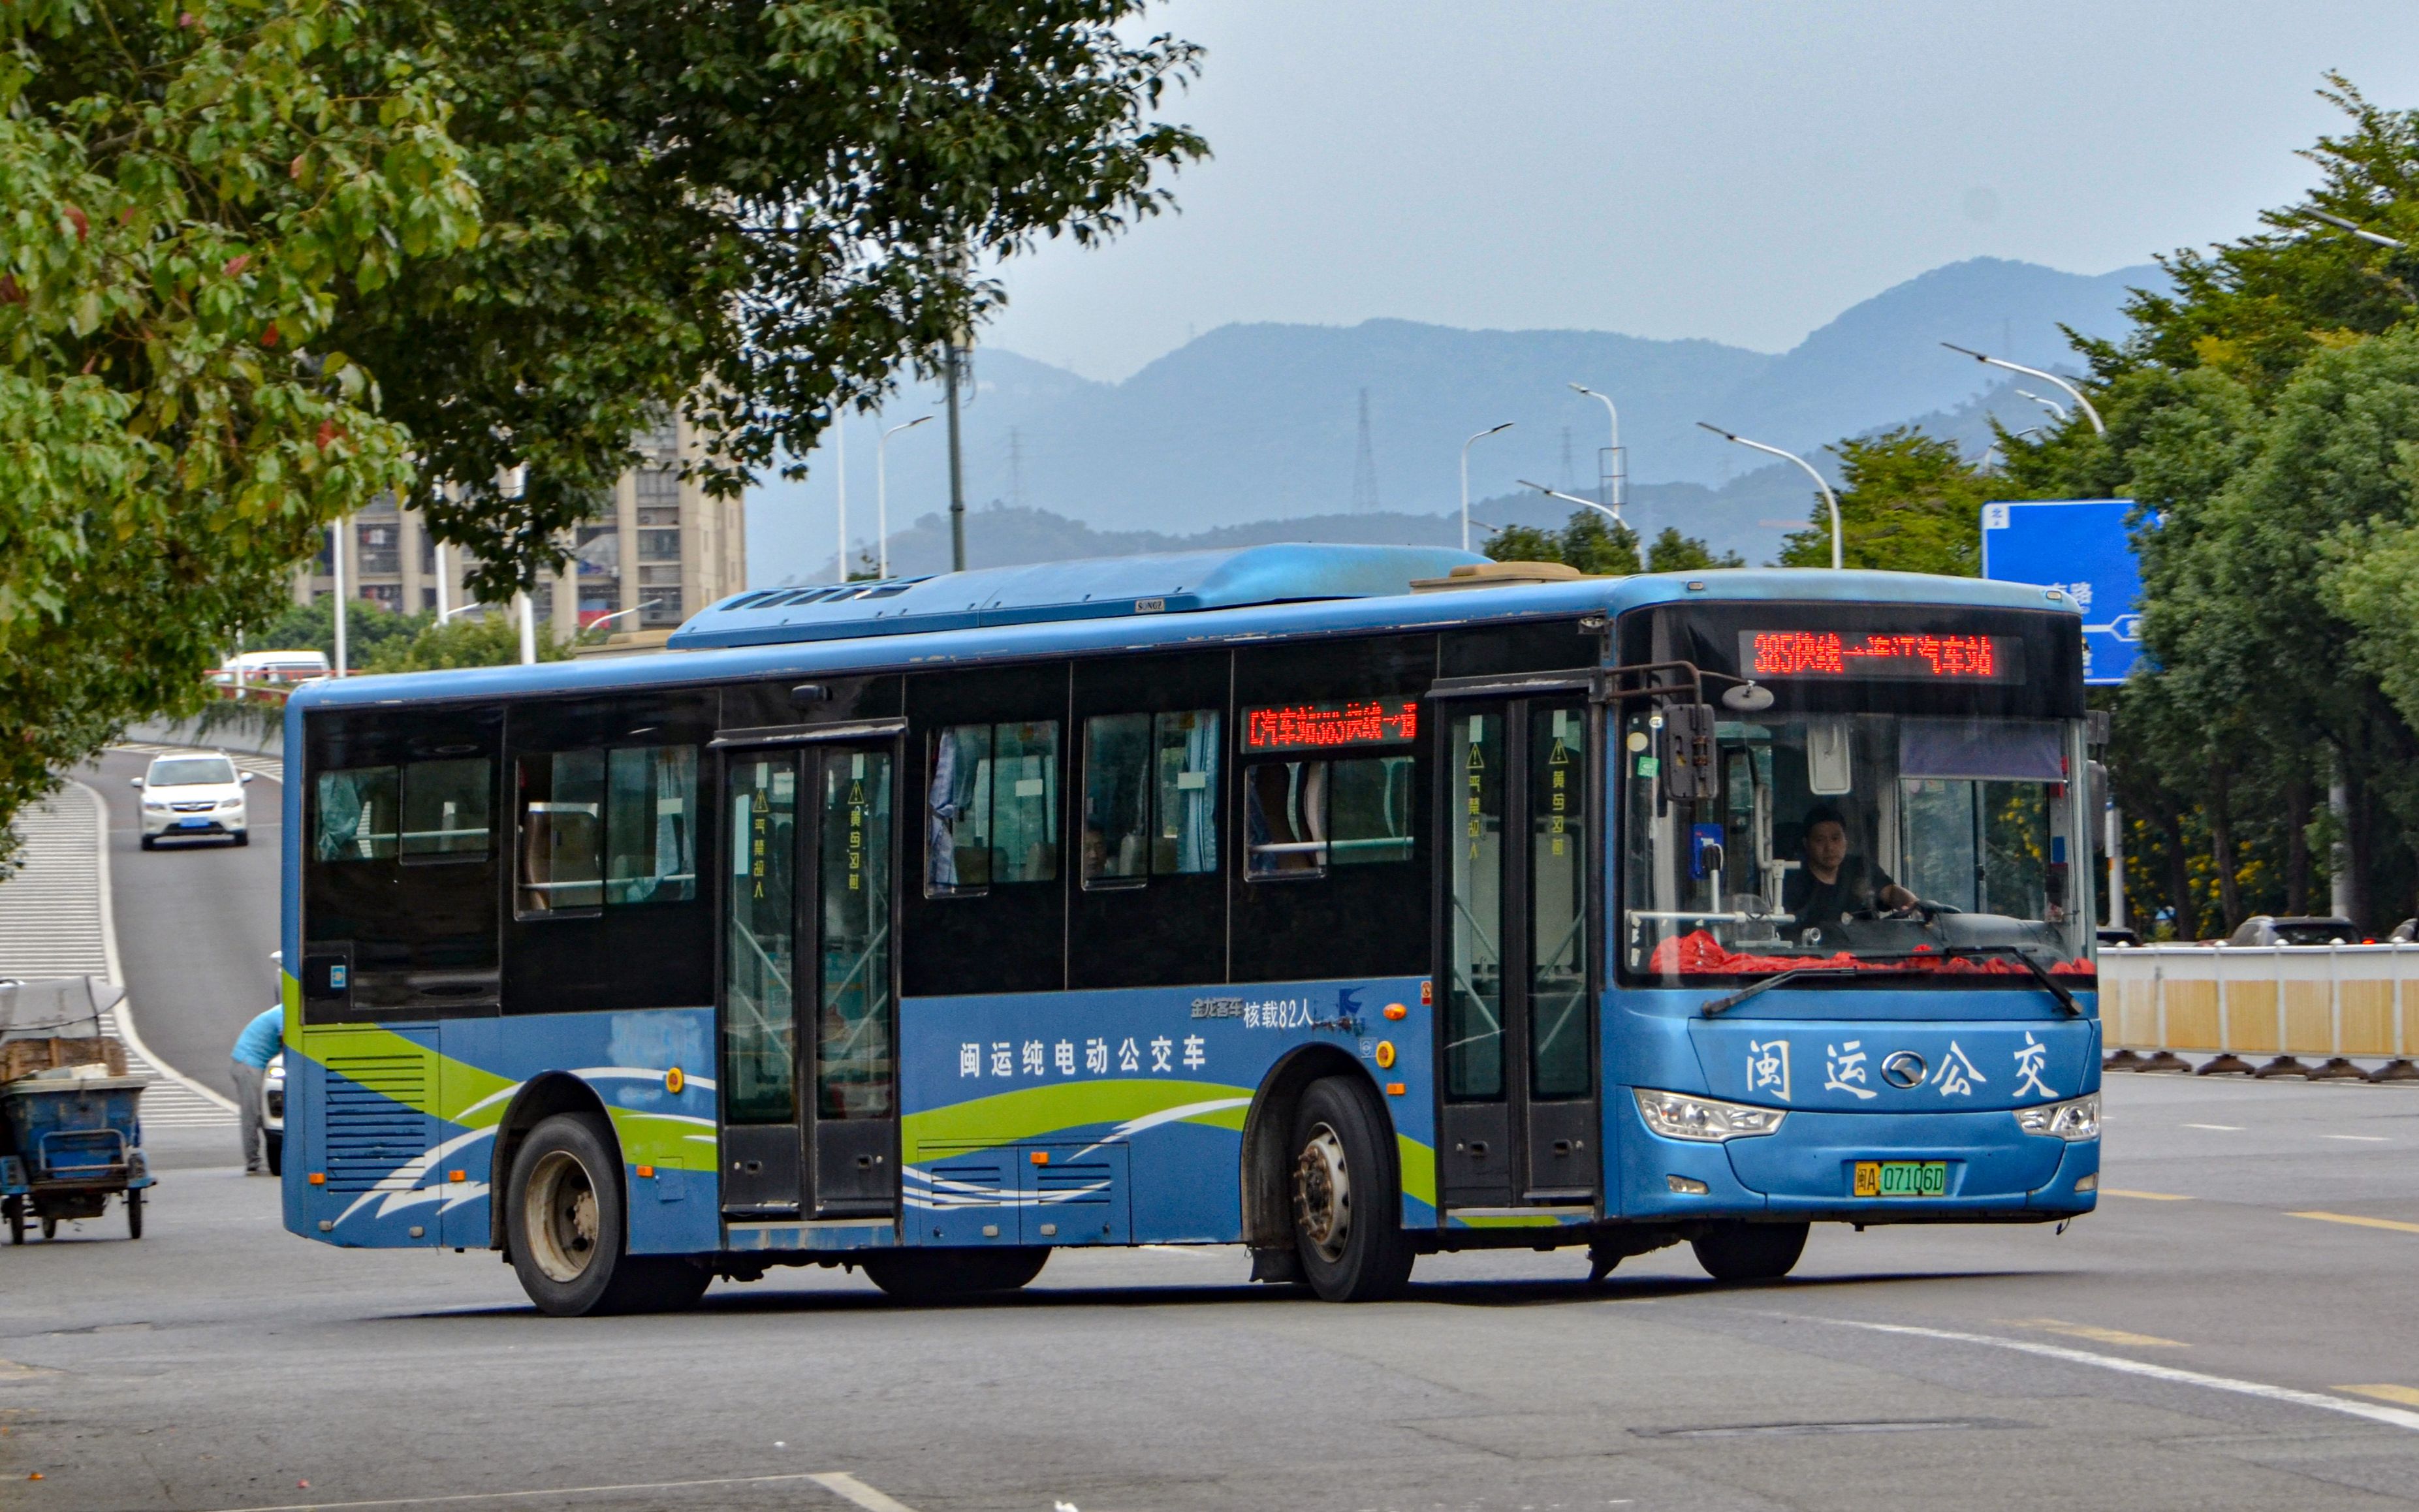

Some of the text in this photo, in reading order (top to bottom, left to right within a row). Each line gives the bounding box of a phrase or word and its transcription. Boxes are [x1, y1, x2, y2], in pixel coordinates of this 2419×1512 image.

[1190, 997, 1243, 1019] 金龙客车
[1243, 998, 1314, 1029] 核载82人
[960, 1034, 1205, 1077] 闽运纯电动公交车
[1747, 1031, 2060, 1102] 闽运公交
